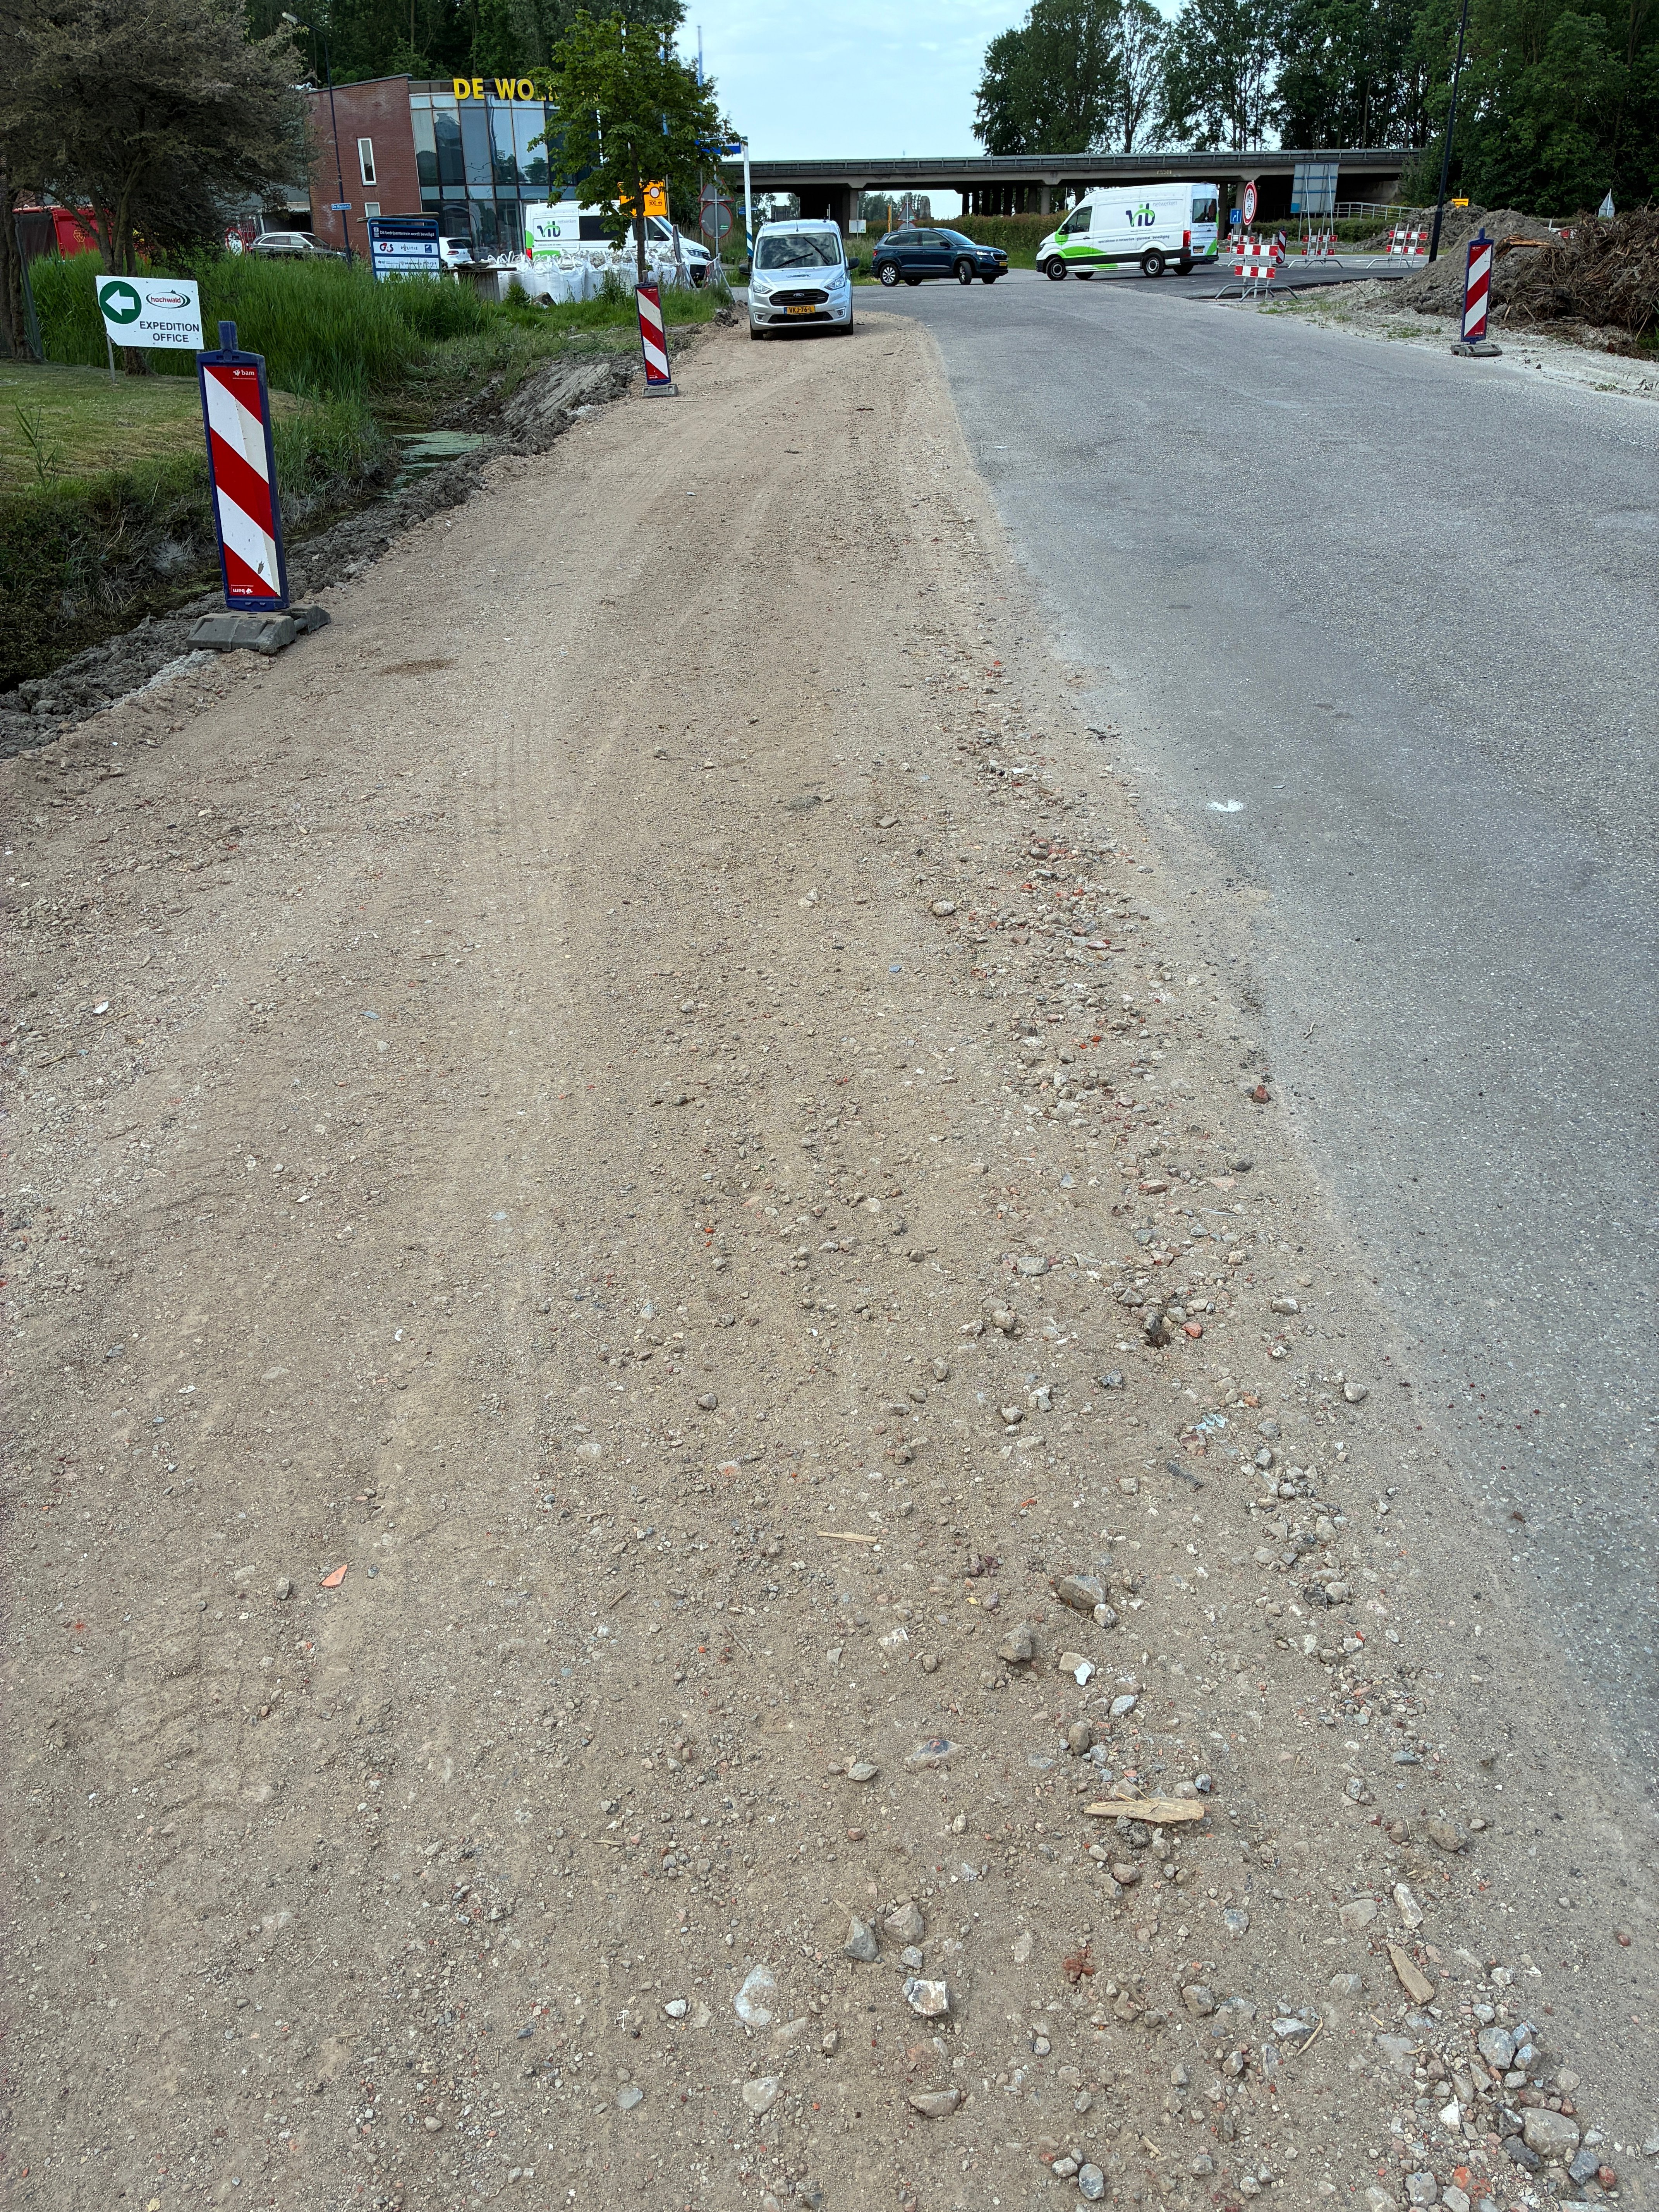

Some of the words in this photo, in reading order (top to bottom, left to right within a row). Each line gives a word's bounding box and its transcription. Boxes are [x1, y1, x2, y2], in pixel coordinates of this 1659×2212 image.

[453, 78, 485, 100] DE
[139, 321, 199, 332] EXPEDITION
[153, 333, 189, 343] OFFICE
